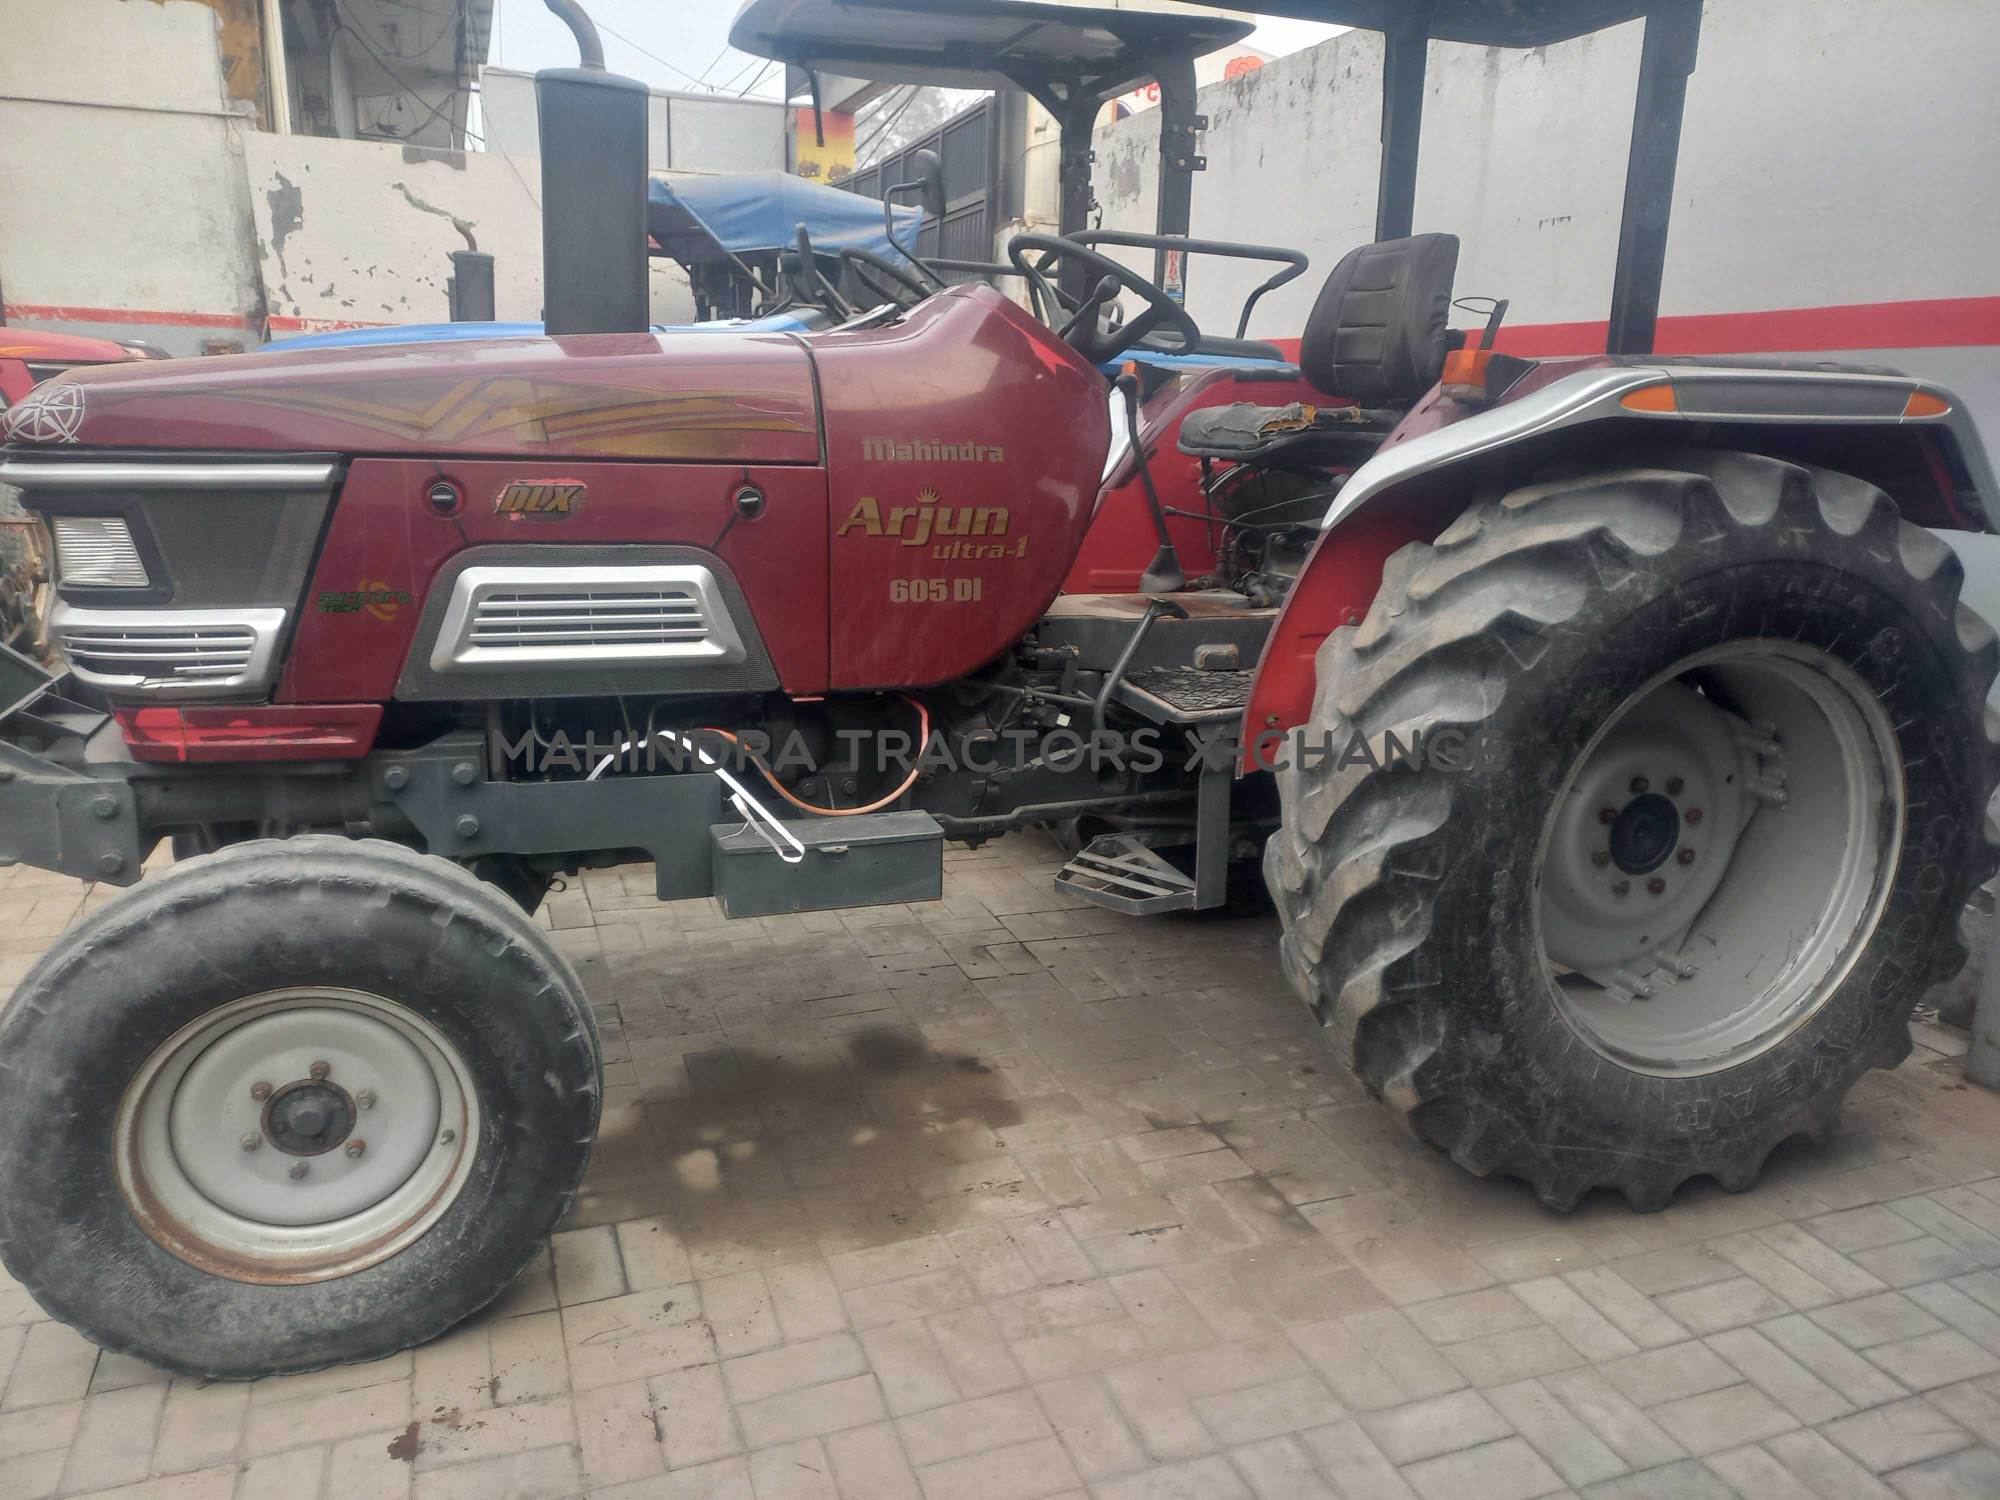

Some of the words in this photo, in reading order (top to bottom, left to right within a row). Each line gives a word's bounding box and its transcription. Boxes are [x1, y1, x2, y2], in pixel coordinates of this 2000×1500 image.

[862, 437, 1005, 462] Mahindra
[498, 484, 580, 512] DLX
[836, 489, 1010, 546] Arjun
[932, 535, 1029, 560] ultra-1
[889, 578, 948, 603] 605
[953, 577, 983, 602] DI
[1673, 813, 1956, 1132] GOODYEAR
